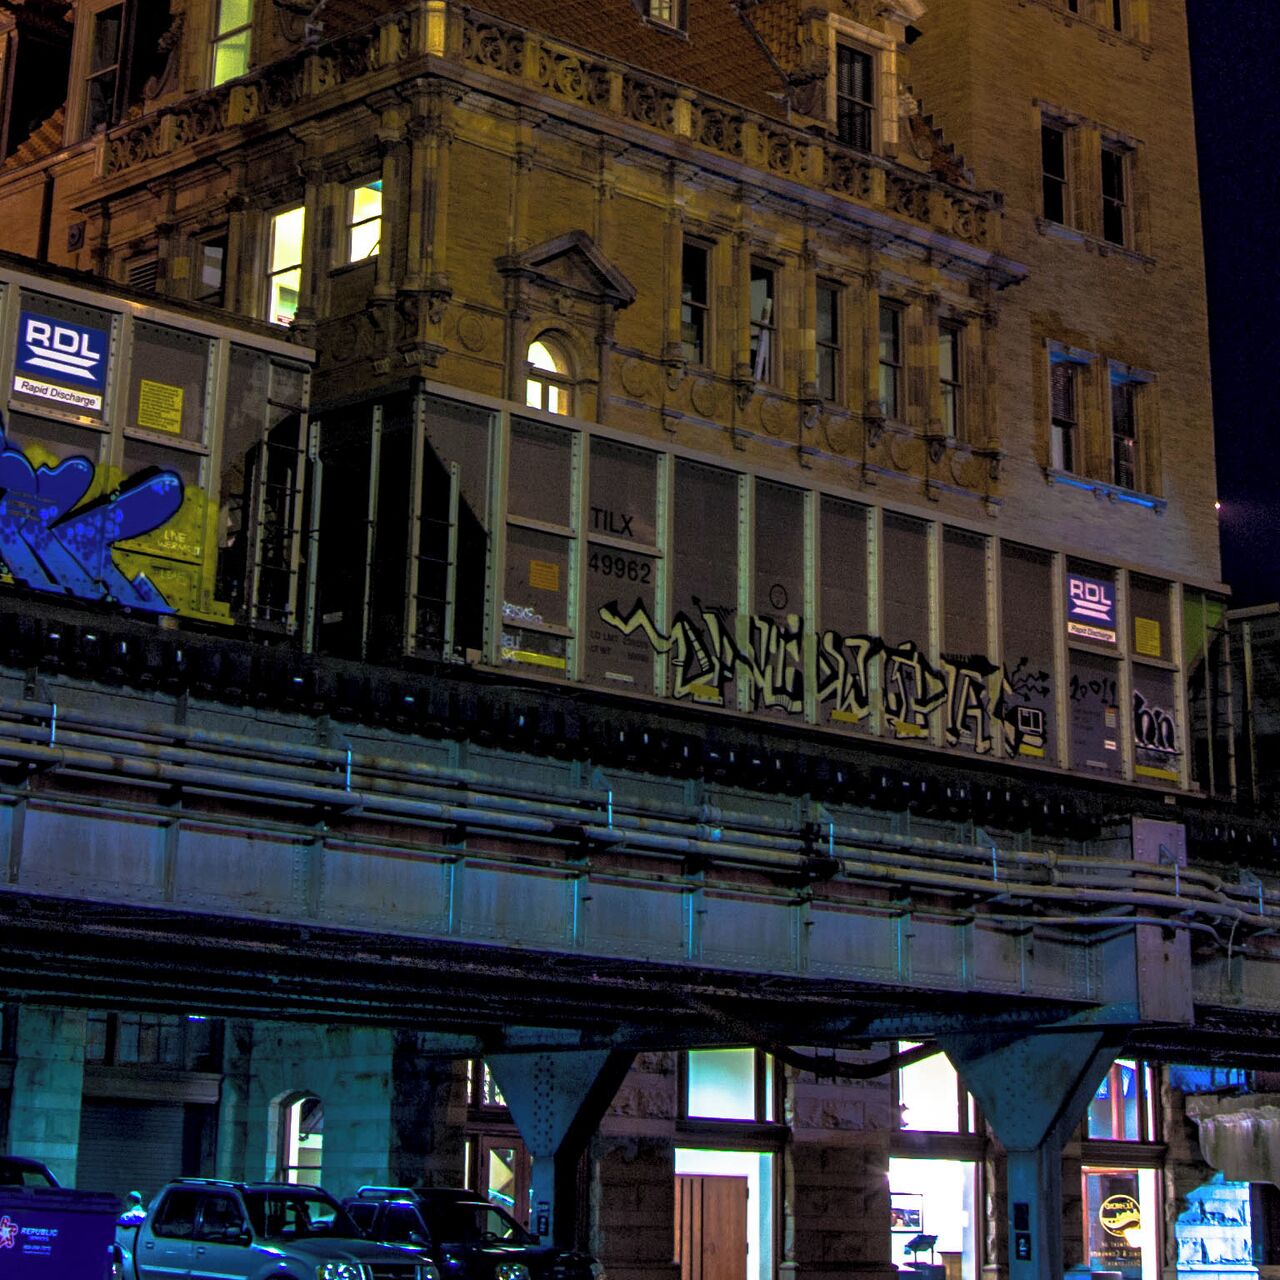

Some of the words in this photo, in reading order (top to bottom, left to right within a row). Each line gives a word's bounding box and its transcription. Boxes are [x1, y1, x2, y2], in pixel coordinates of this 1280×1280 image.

[25, 318, 101, 361] RDL
[21, 380, 48, 396] Rapid
[50, 388, 96, 407] Discharge
[591, 506, 634, 537] TILX
[588, 553, 651, 585] 49962
[1070, 578, 1112, 606] RDL
